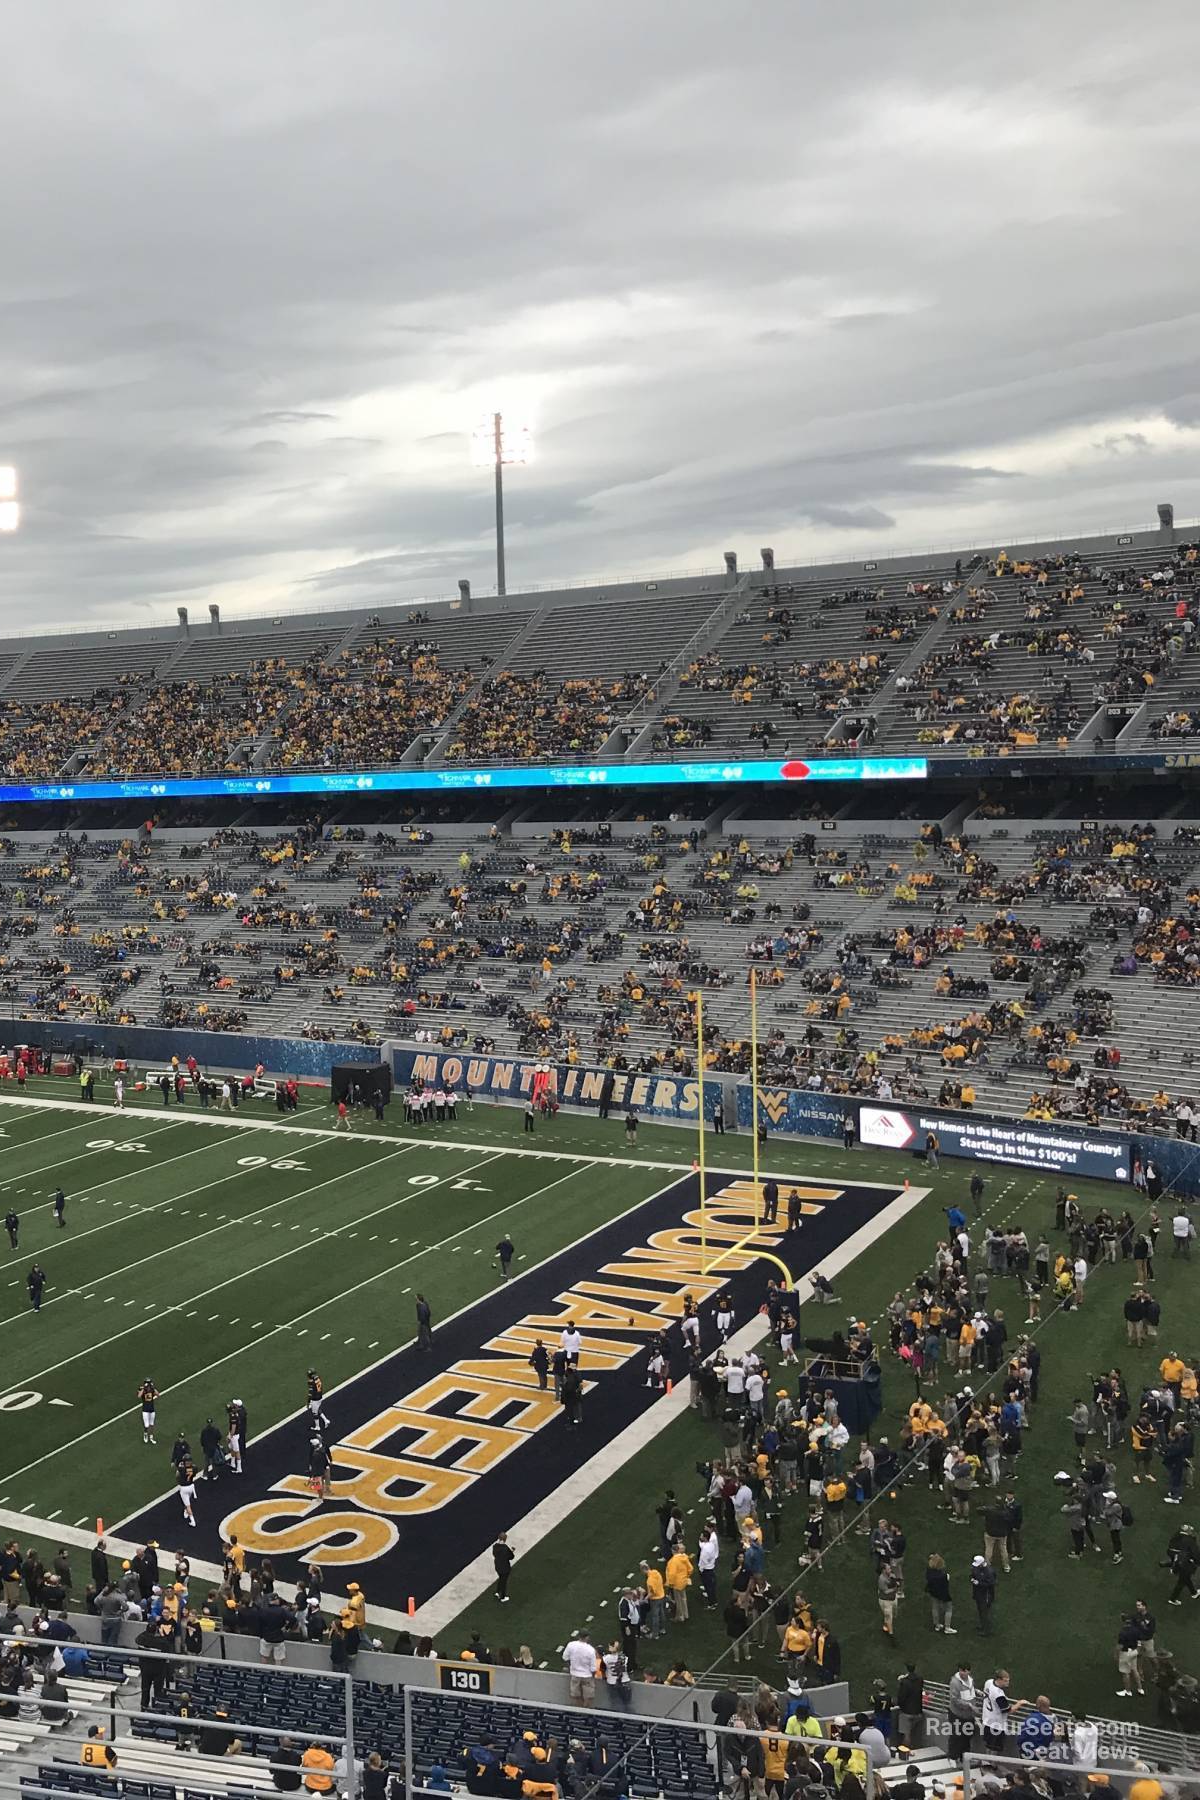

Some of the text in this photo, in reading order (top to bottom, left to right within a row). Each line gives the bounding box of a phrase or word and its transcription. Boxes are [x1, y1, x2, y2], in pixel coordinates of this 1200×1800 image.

[799, 1109, 845, 1122] NISSAN
[920, 1118, 1122, 1156] New Homes in the Heart of Mountaineer Country!
[959, 1137, 1003, 1153] Starting
[1004, 1143, 1014, 1153] in
[1016, 1144, 1036, 1157] the
[1037, 1147, 1077, 1164] $100's!
[450, 1671, 480, 1690] 130
[84, 1746, 93, 1762] 8
